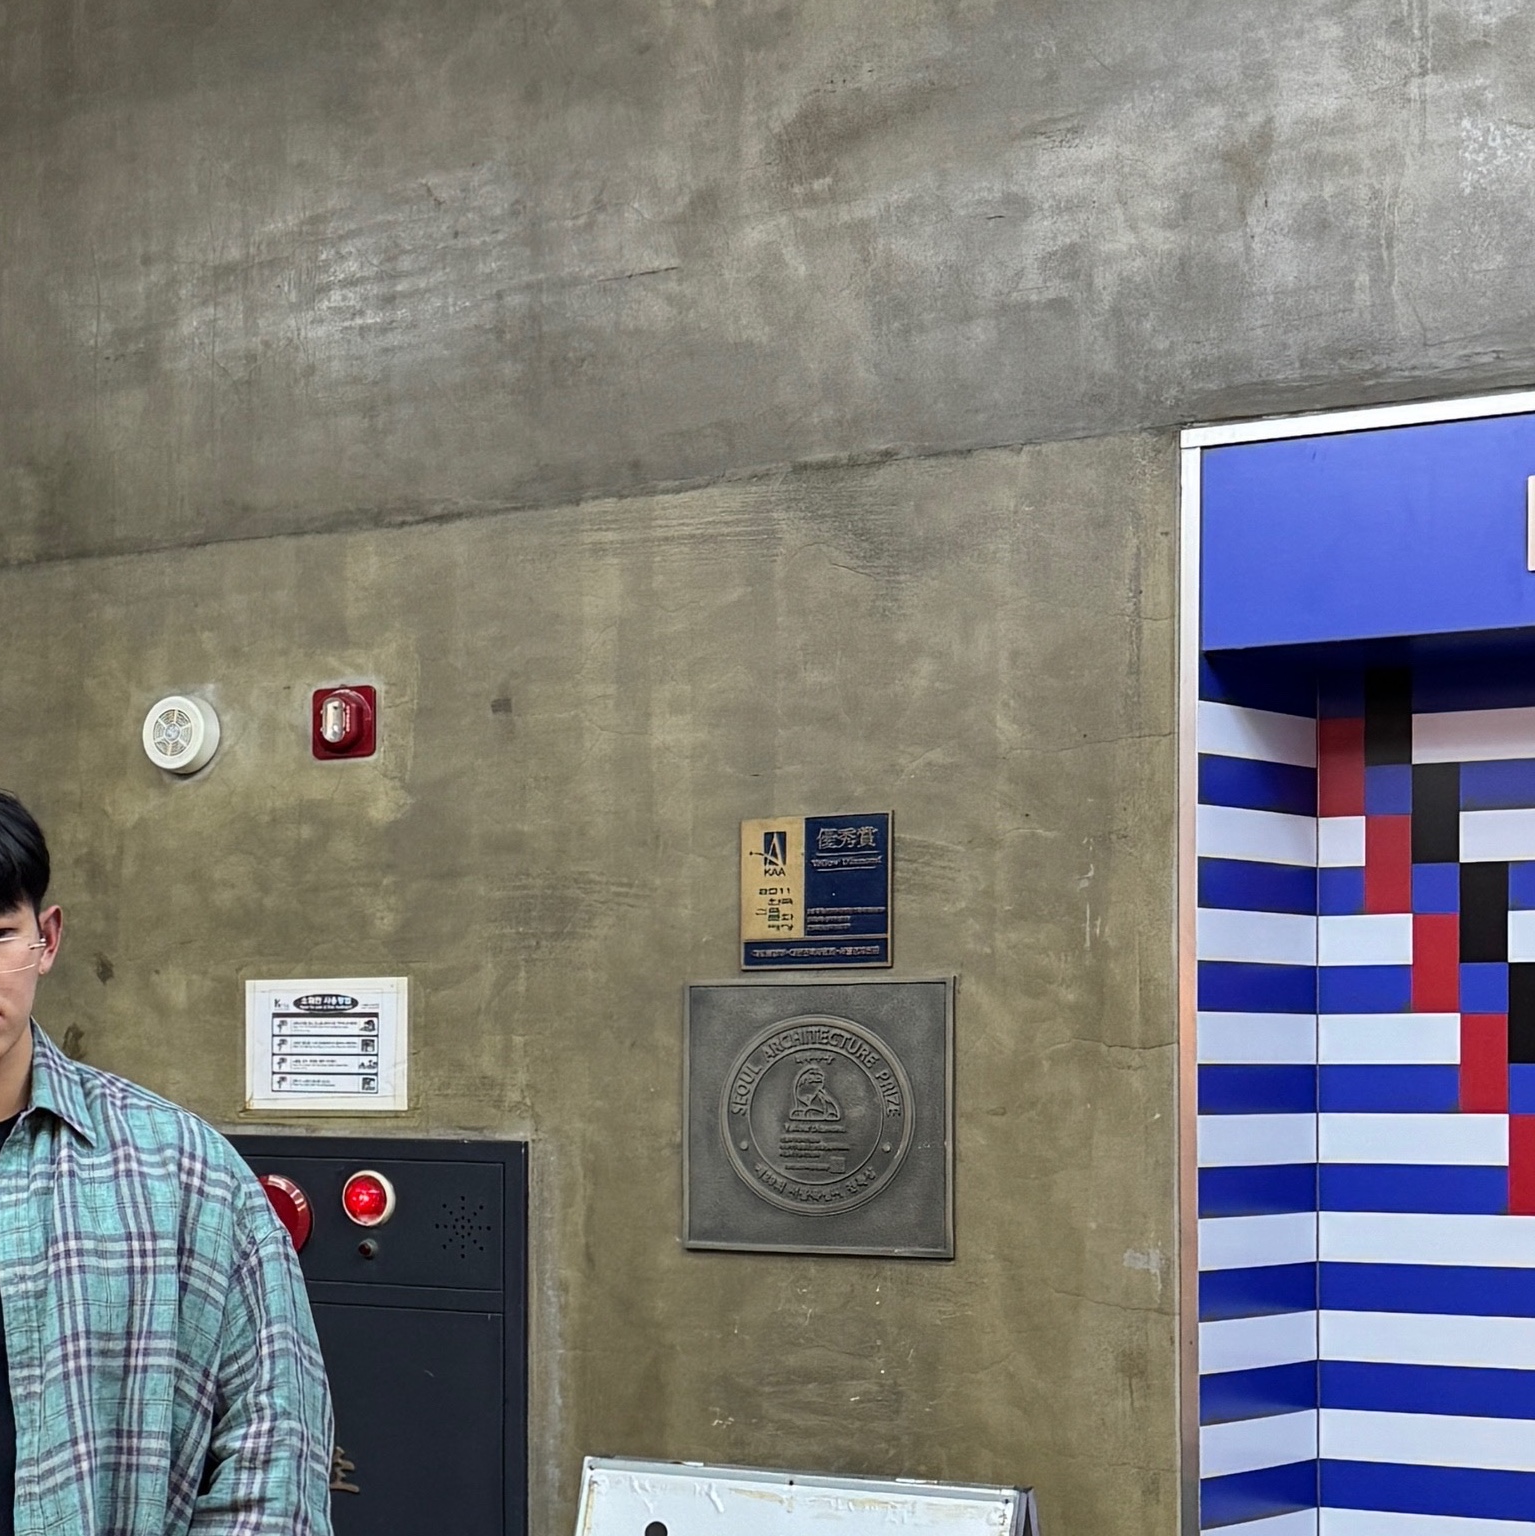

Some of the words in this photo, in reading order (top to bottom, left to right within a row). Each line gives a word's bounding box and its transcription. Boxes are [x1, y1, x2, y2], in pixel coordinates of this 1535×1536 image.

[764, 867, 786, 877] KAA
[731, 1065, 762, 1117] SEOUL
[764, 1028, 880, 1070] ARCHITECTURE
[875, 1069, 901, 1118] PRIZE
